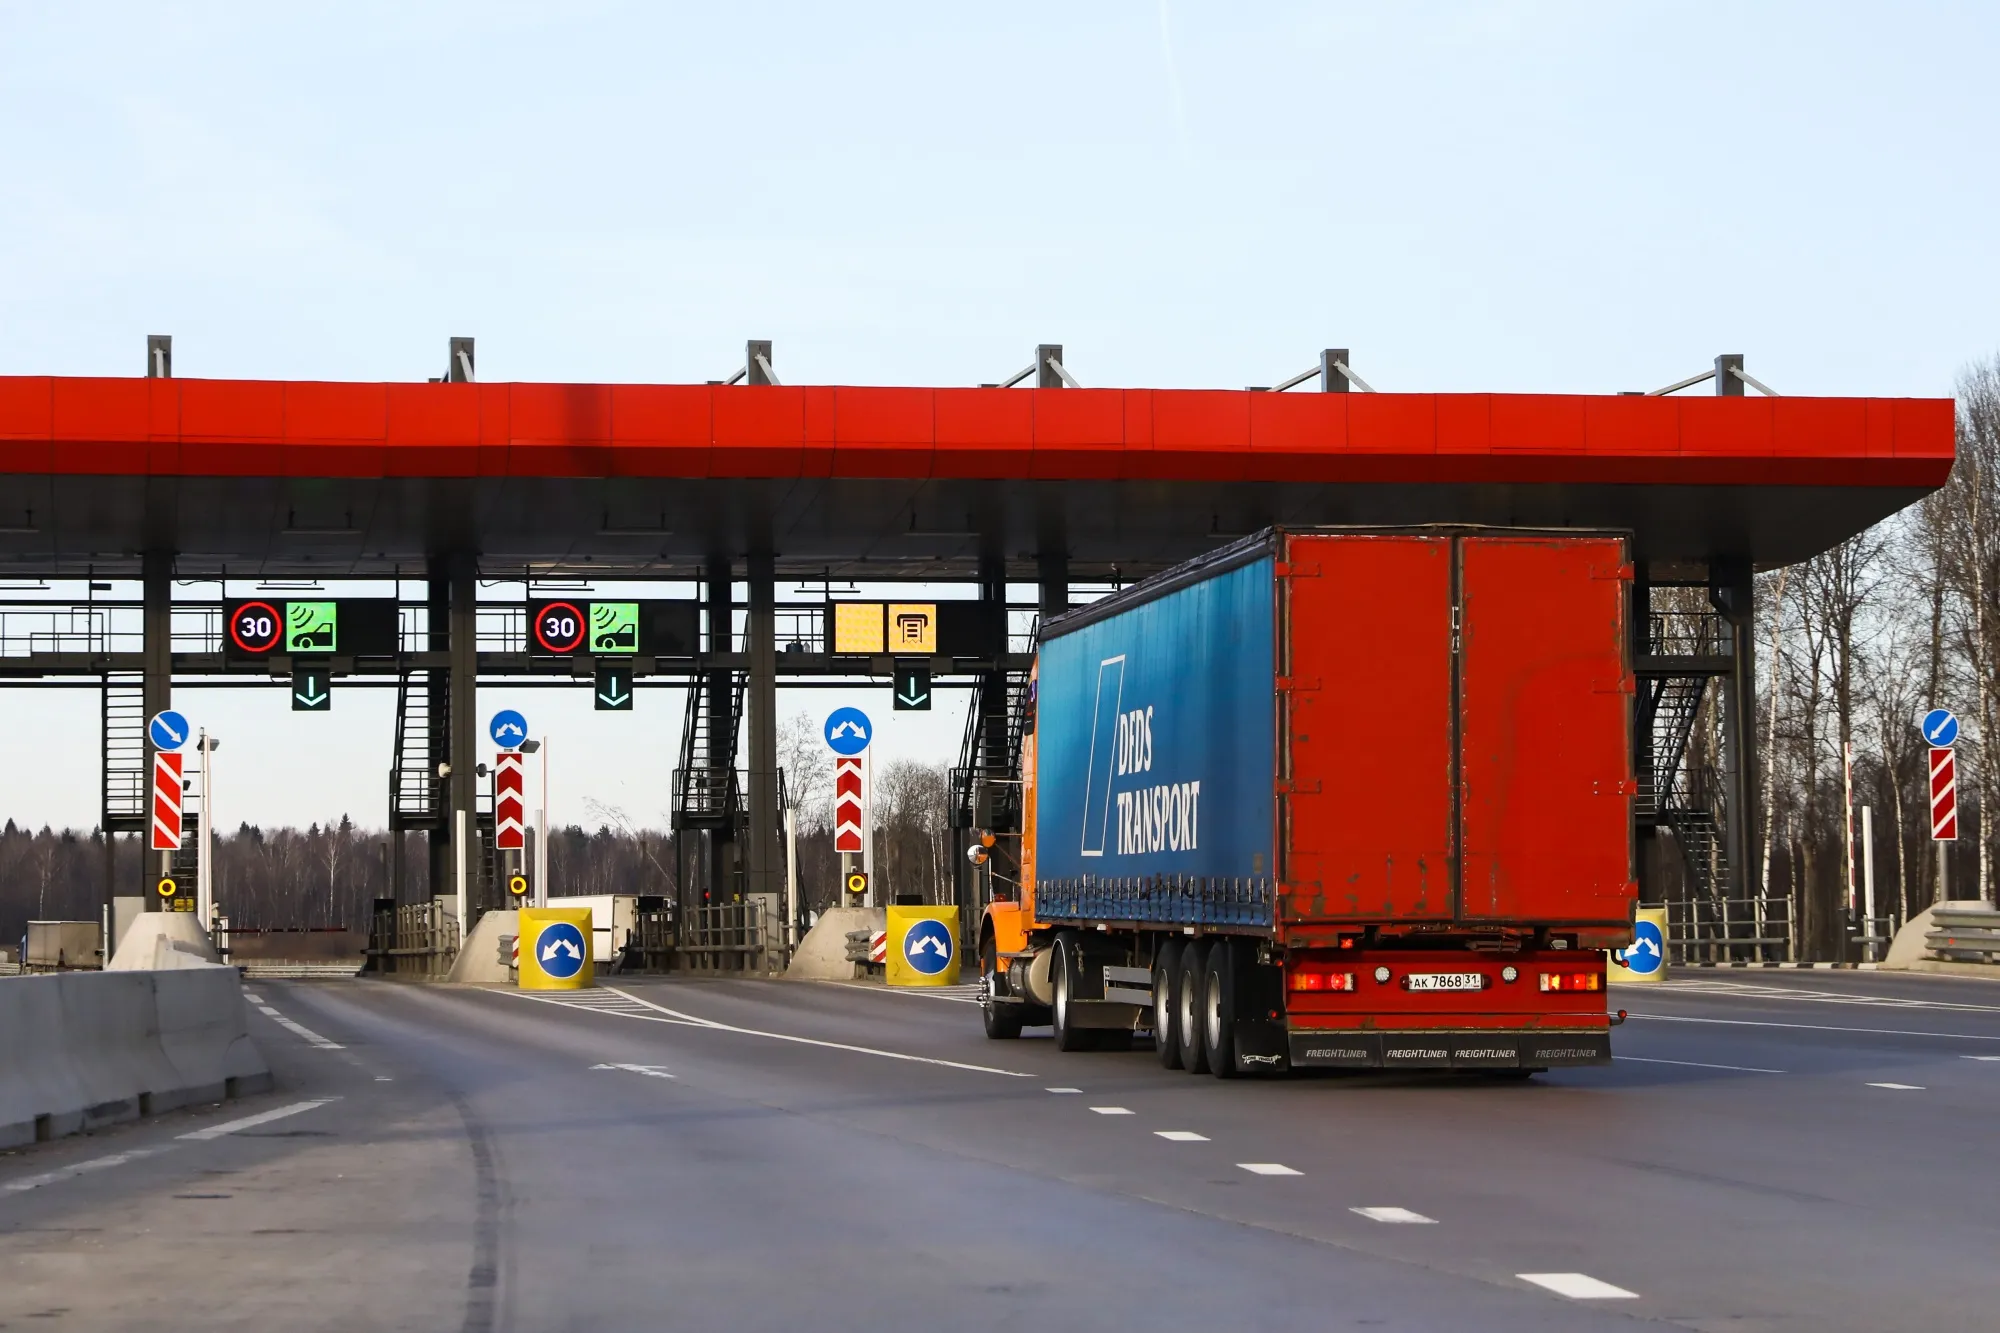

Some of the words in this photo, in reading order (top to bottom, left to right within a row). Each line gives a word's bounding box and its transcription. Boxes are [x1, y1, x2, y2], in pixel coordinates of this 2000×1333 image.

[241, 617, 271, 637] 30
[545, 618, 574, 637] 30
[1118, 705, 1153, 776] DFDS
[1117, 780, 1200, 855] TRANSPORT
[1414, 979, 1427, 987] AK
[1432, 976, 1461, 987] 7868
[1465, 975, 1476, 984] 31
[1306, 1049, 1367, 1058] FREIGHTLINER
[1387, 1049, 1447, 1058] FREIGHTLINER
[1455, 1049, 1516, 1058] FREIGHTLINER
[1535, 1049, 1597, 1058] FREIGHTLINER
